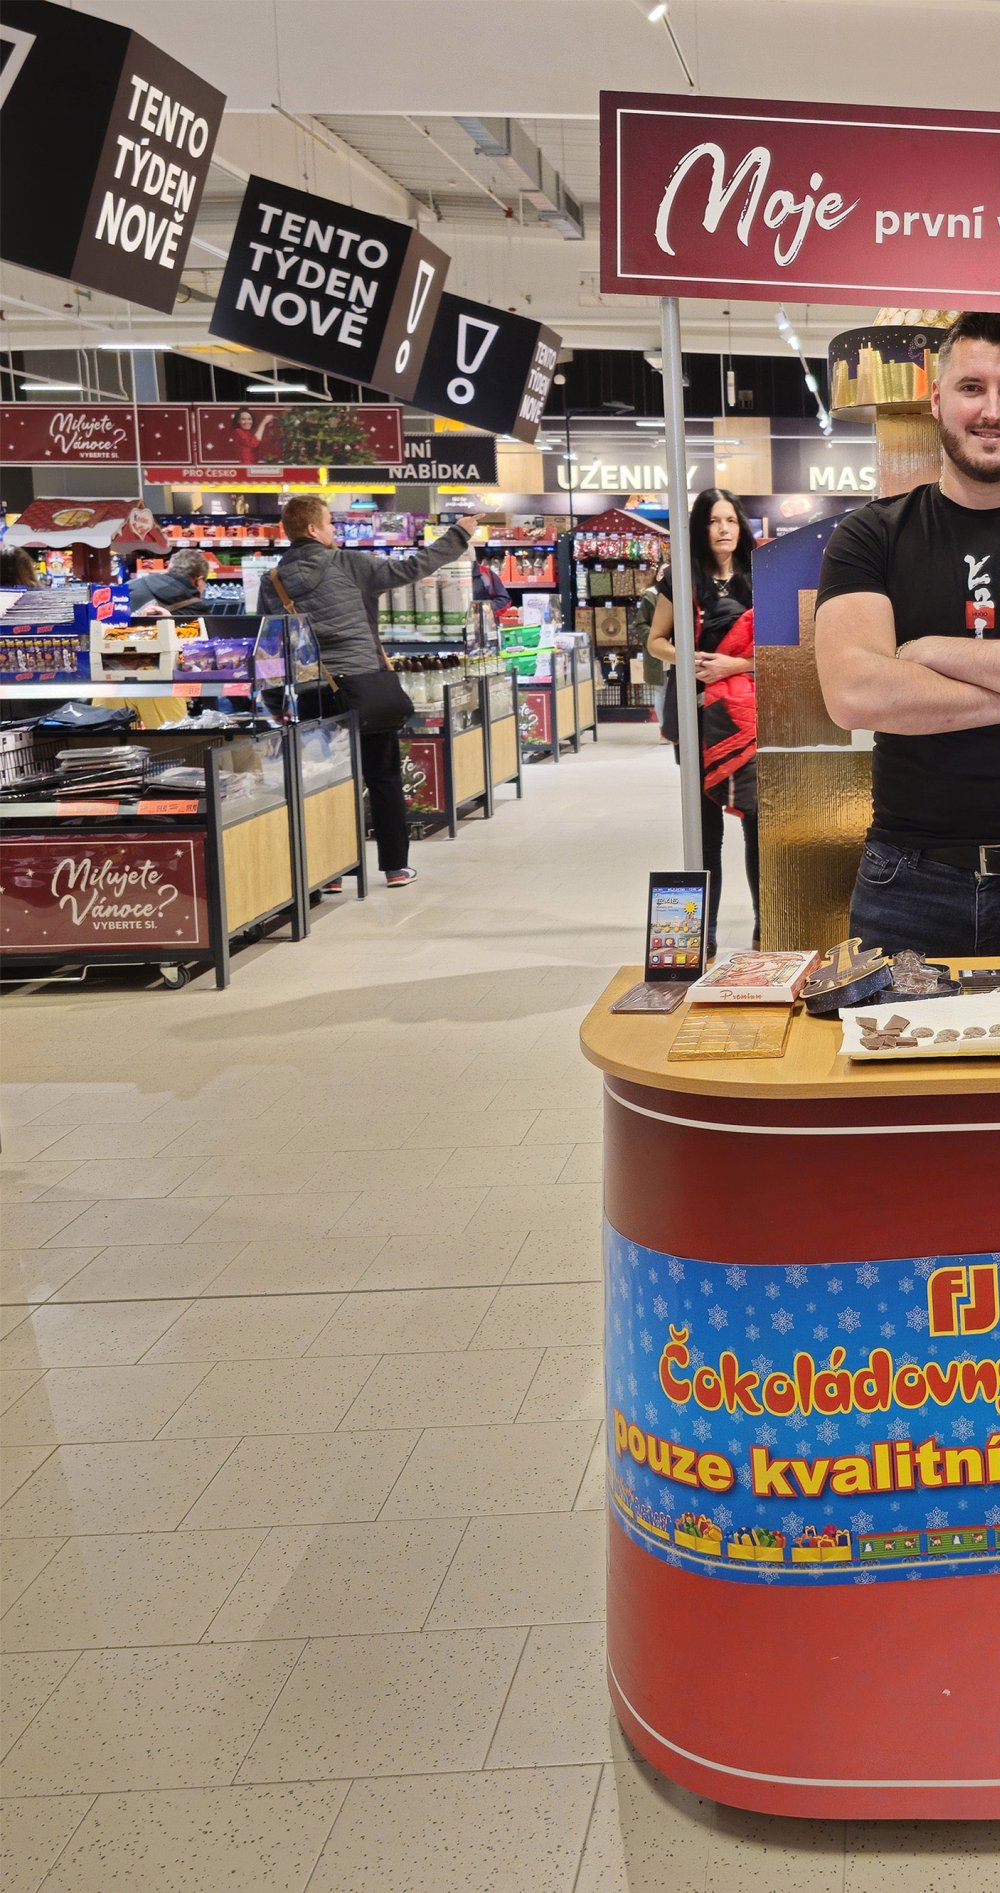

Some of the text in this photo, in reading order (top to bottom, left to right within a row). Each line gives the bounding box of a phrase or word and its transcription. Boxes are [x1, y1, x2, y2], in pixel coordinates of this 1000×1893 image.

[128, 74, 209, 159] TENTO
[114, 134, 197, 213] TÝDEN
[95, 191, 184, 270] NOVĚ
[654, 142, 860, 266] Moje
[875, 205, 985, 244] první
[258, 203, 388, 269] TENTO
[249, 242, 378, 308] TÝDEN
[235, 278, 368, 348] NOVĚ
[50, 413, 114, 437] Milujete
[54, 428, 127, 454] Vánoce?
[182, 468, 238, 477] PRO ČESKO
[809, 466, 877, 491] MAS
[51, 858, 164, 898] Milujete
[59, 884, 179, 926] Vánoce?
[93, 920, 158, 930] VYBERTE SI.
[720, 989, 763, 1001] Premium
[612, 1407, 736, 1494] pouze
